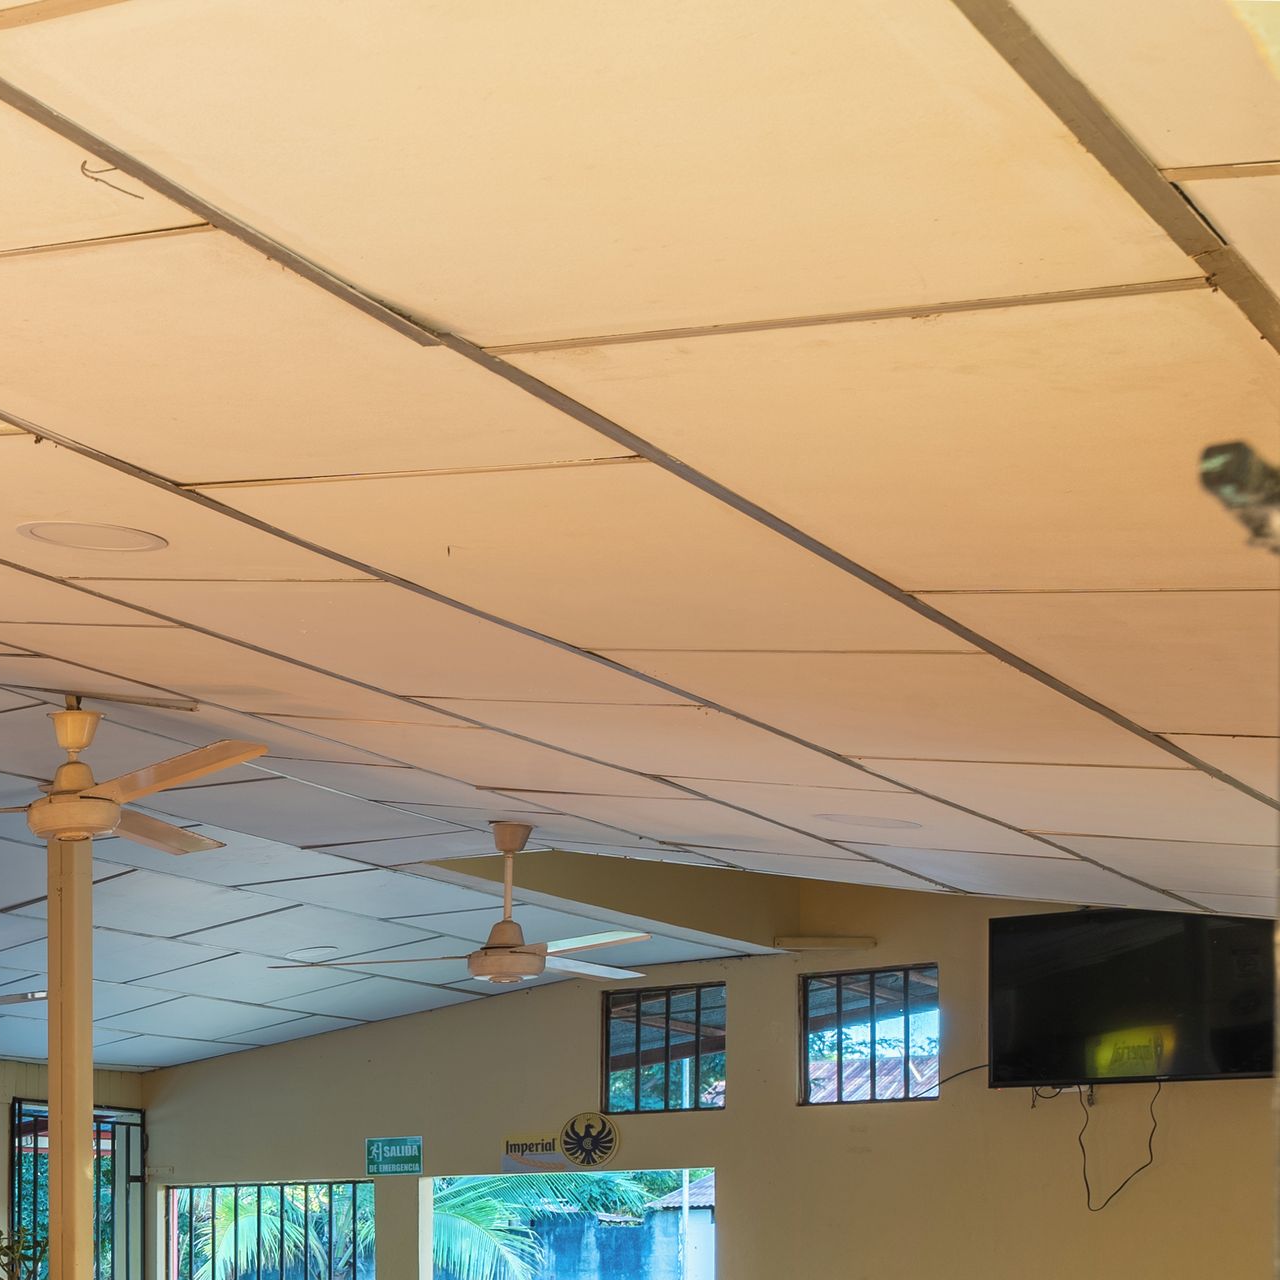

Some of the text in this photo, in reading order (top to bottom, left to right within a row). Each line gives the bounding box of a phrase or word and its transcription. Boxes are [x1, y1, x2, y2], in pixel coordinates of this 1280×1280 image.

[383, 1145, 419, 1157] SALIDA
[505, 1137, 557, 1157] Imperial
[369, 1163, 420, 1173] DE EMERGENCIA
